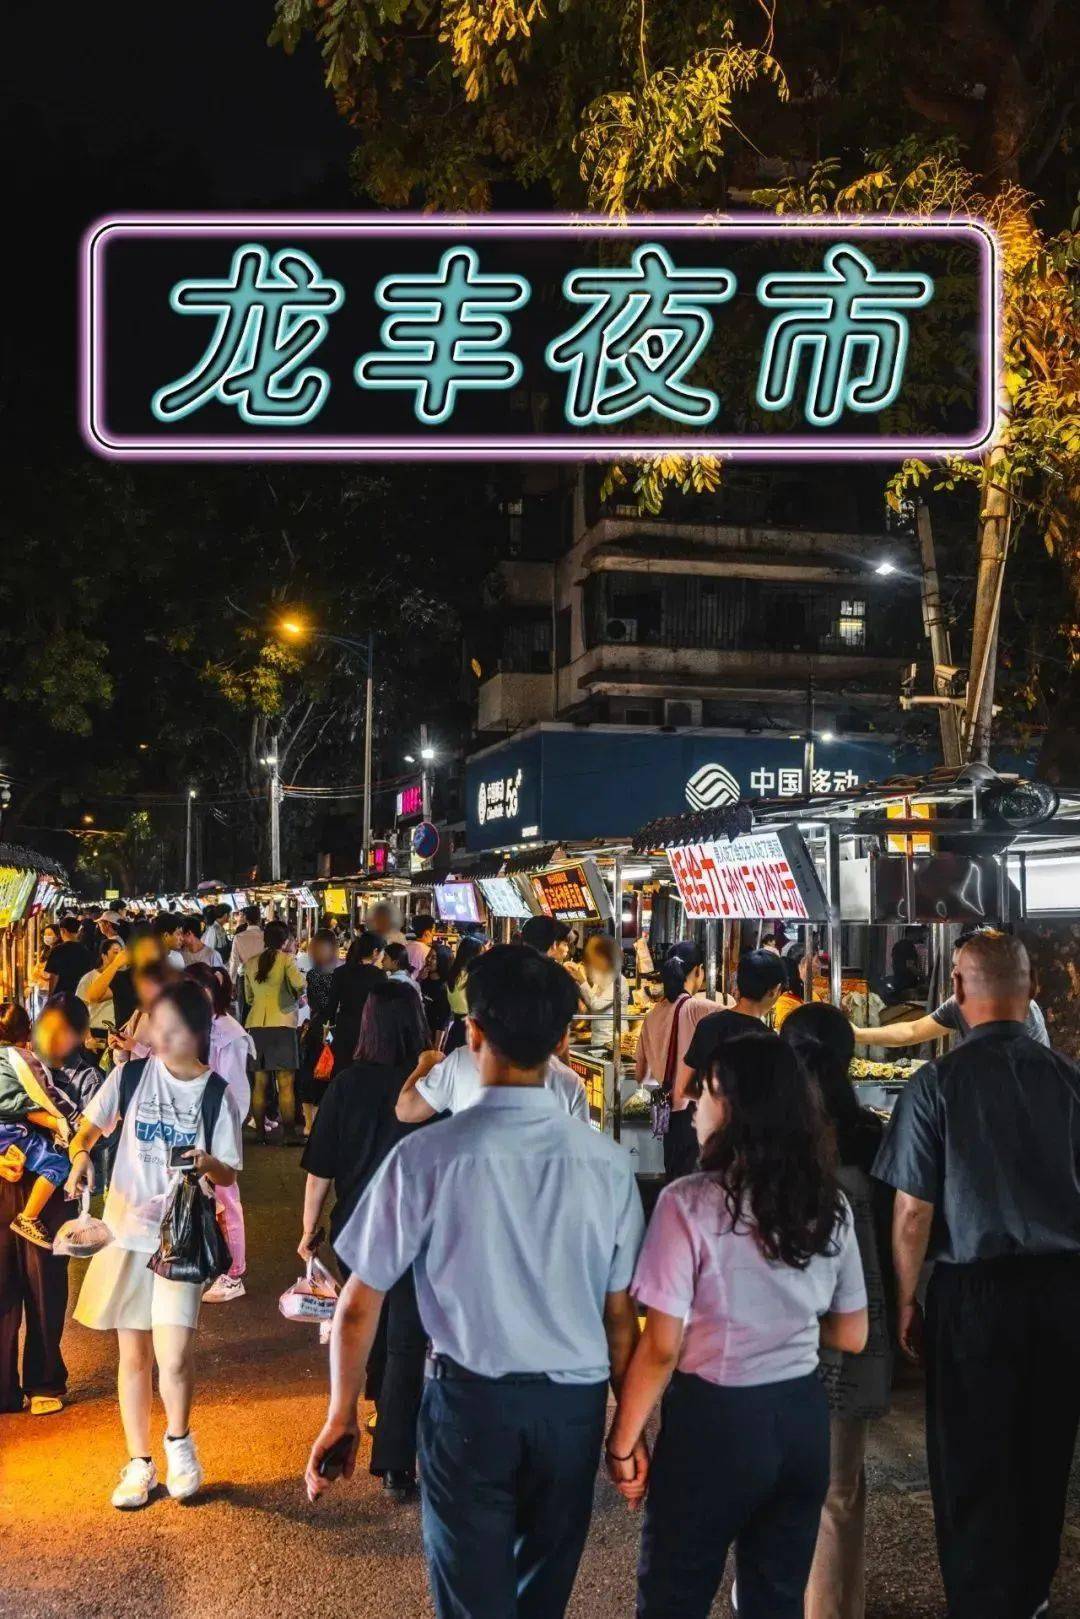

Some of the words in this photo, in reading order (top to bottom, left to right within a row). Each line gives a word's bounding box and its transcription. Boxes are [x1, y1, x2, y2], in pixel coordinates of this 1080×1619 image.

[751, 767, 859, 796] 中国移动
[136, 1122, 196, 1145] HAPPY
